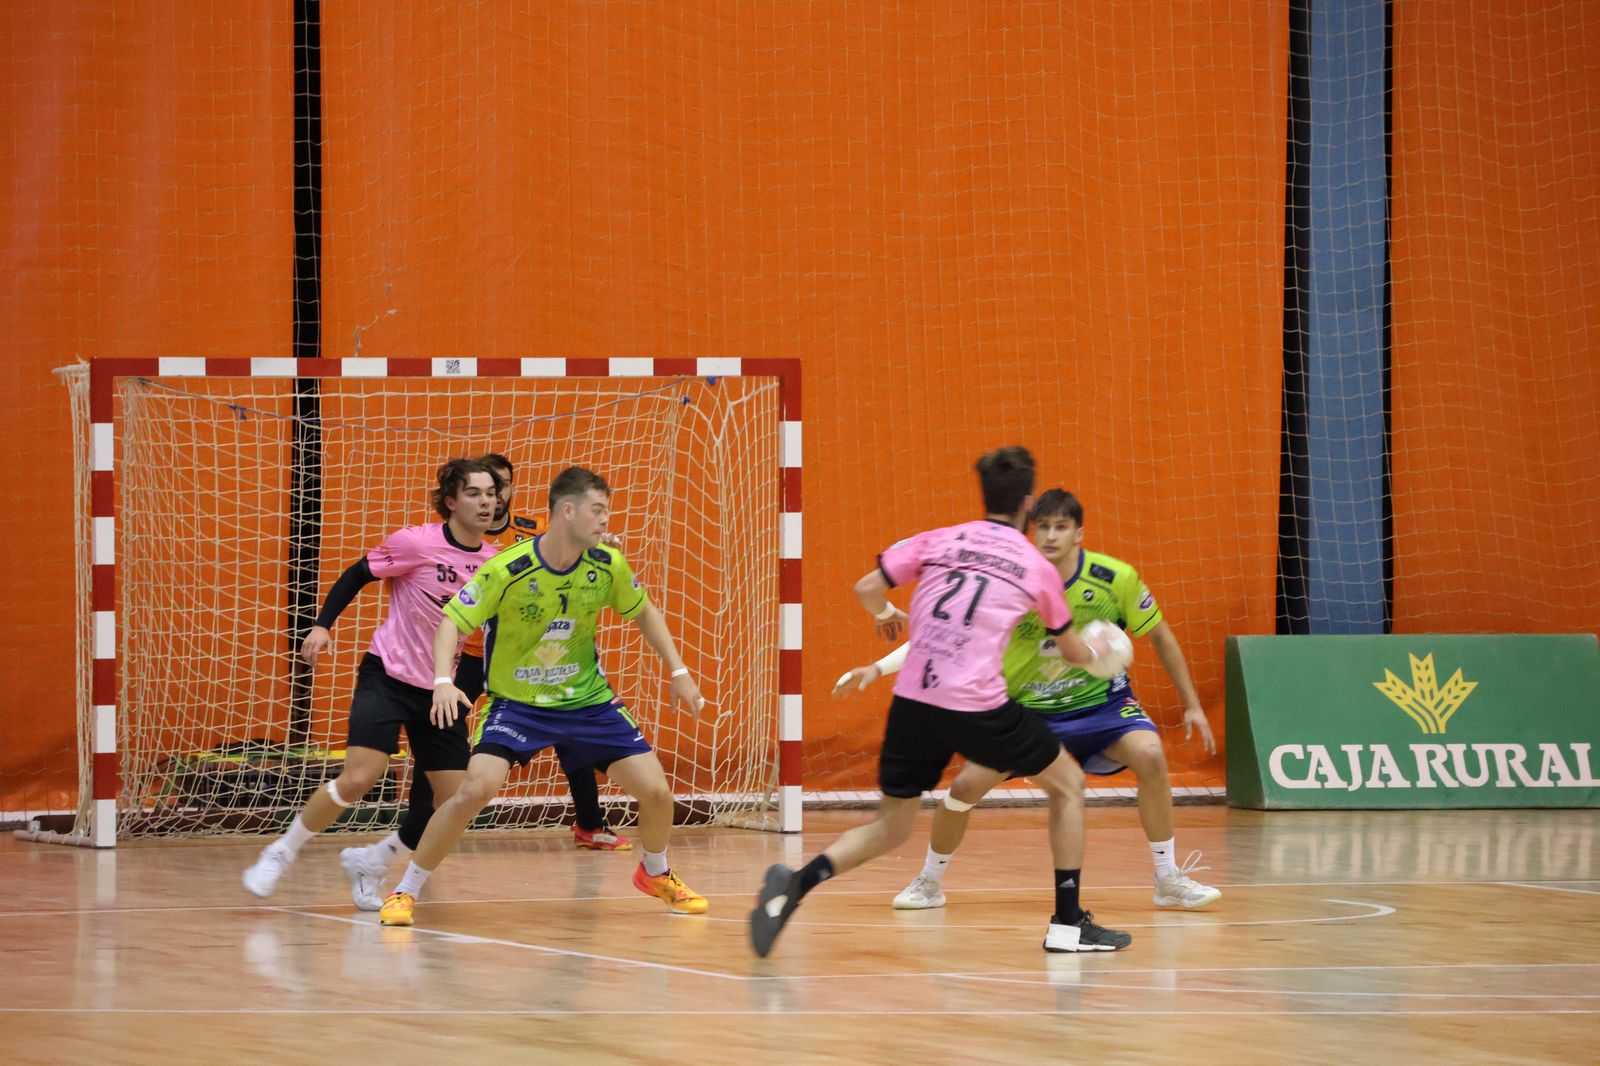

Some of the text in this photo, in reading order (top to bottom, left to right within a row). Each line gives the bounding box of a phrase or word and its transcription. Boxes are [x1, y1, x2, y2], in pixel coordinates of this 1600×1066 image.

[437, 563, 457, 583] 55
[1269, 743, 1600, 792] CAJA RURAL
